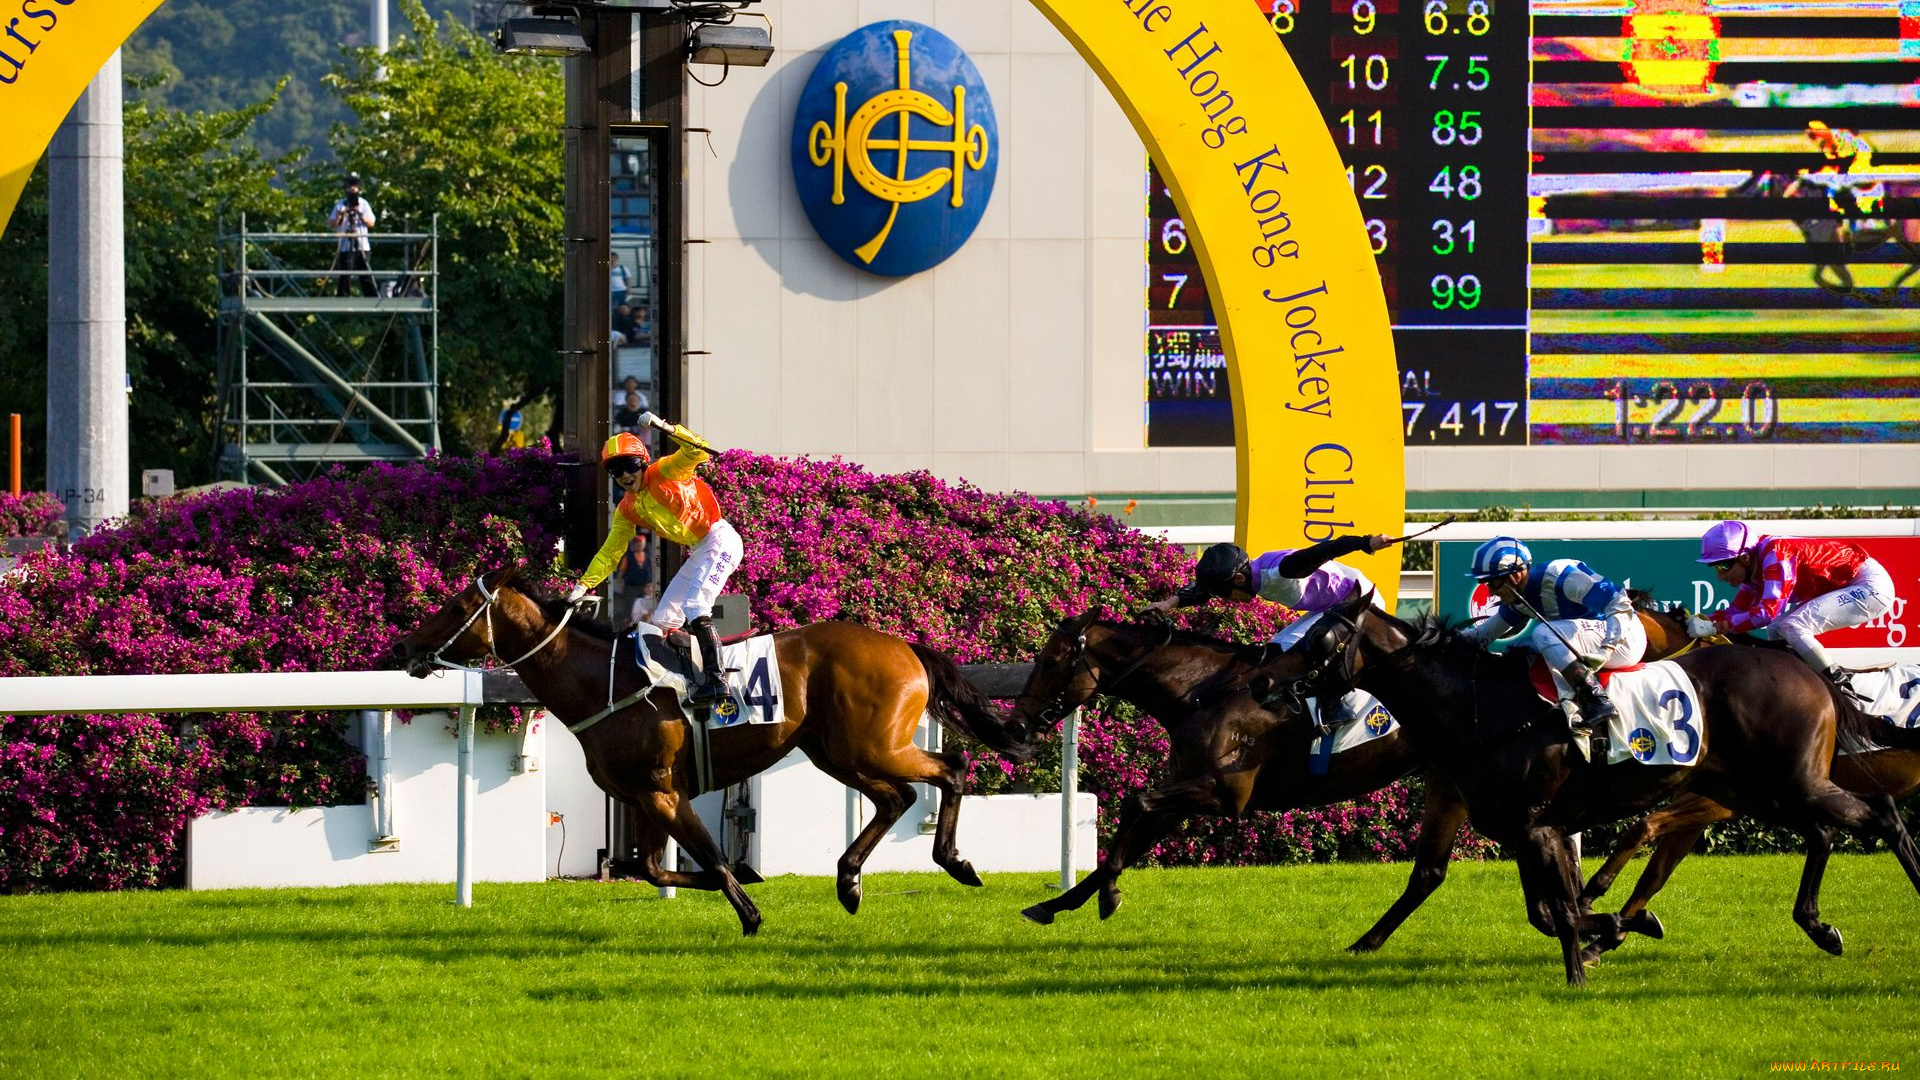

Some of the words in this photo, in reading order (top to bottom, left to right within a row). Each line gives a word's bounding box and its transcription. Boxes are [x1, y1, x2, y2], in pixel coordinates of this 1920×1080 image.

[1271, 0, 1295, 34] 8
[1352, 0, 1376, 35] 9
[1424, 0, 1490, 36] 6.8
[1163, 21, 1248, 149] Hong
[1340, 54, 1389, 91] 10
[1425, 55, 1490, 91] 7.5
[1340, 109, 1382, 145] 11
[1432, 109, 1483, 146] 85
[1428, 165, 1482, 200] 48
[1233, 143, 1299, 268] Kong
[1162, 218, 1187, 254] 6
[1432, 219, 1475, 255] 31
[1163, 273, 1188, 308] 7
[1431, 274, 1482, 310] 99
[1263, 280, 1344, 418] Jockey
[1151, 371, 1216, 396] WIN
[1603, 380, 1774, 436] 1:22.0
[1303, 443, 1355, 543] Club
[744, 657, 778, 722] 4
[1659, 689, 1700, 763] 3
